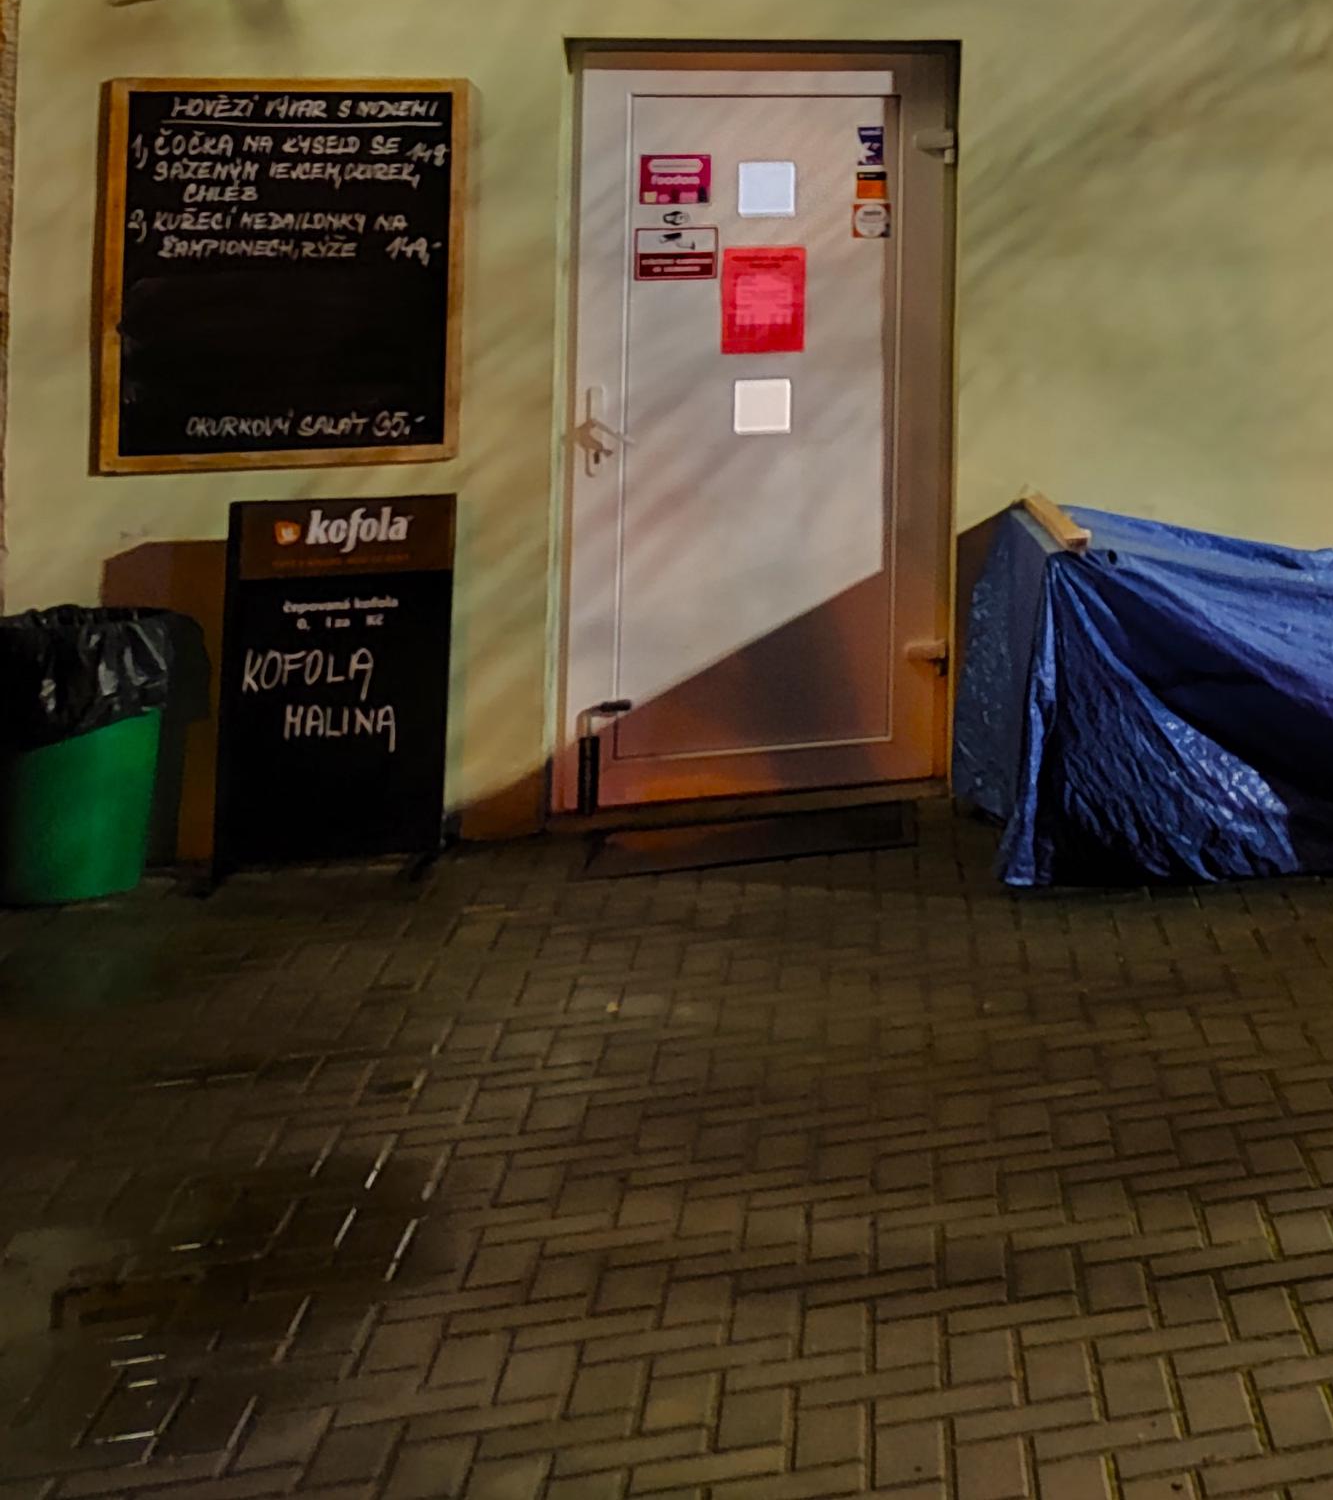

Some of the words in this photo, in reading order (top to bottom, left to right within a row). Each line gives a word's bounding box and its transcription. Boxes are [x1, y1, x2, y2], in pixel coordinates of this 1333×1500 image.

[154, 128, 234, 157] ČOČKA
[242, 135, 274, 155] NA
[369, 135, 402, 154] SE
[373, 214, 409, 231] NA
[305, 506, 409, 553] kofola
[241, 646, 375, 701] KOFOLA
